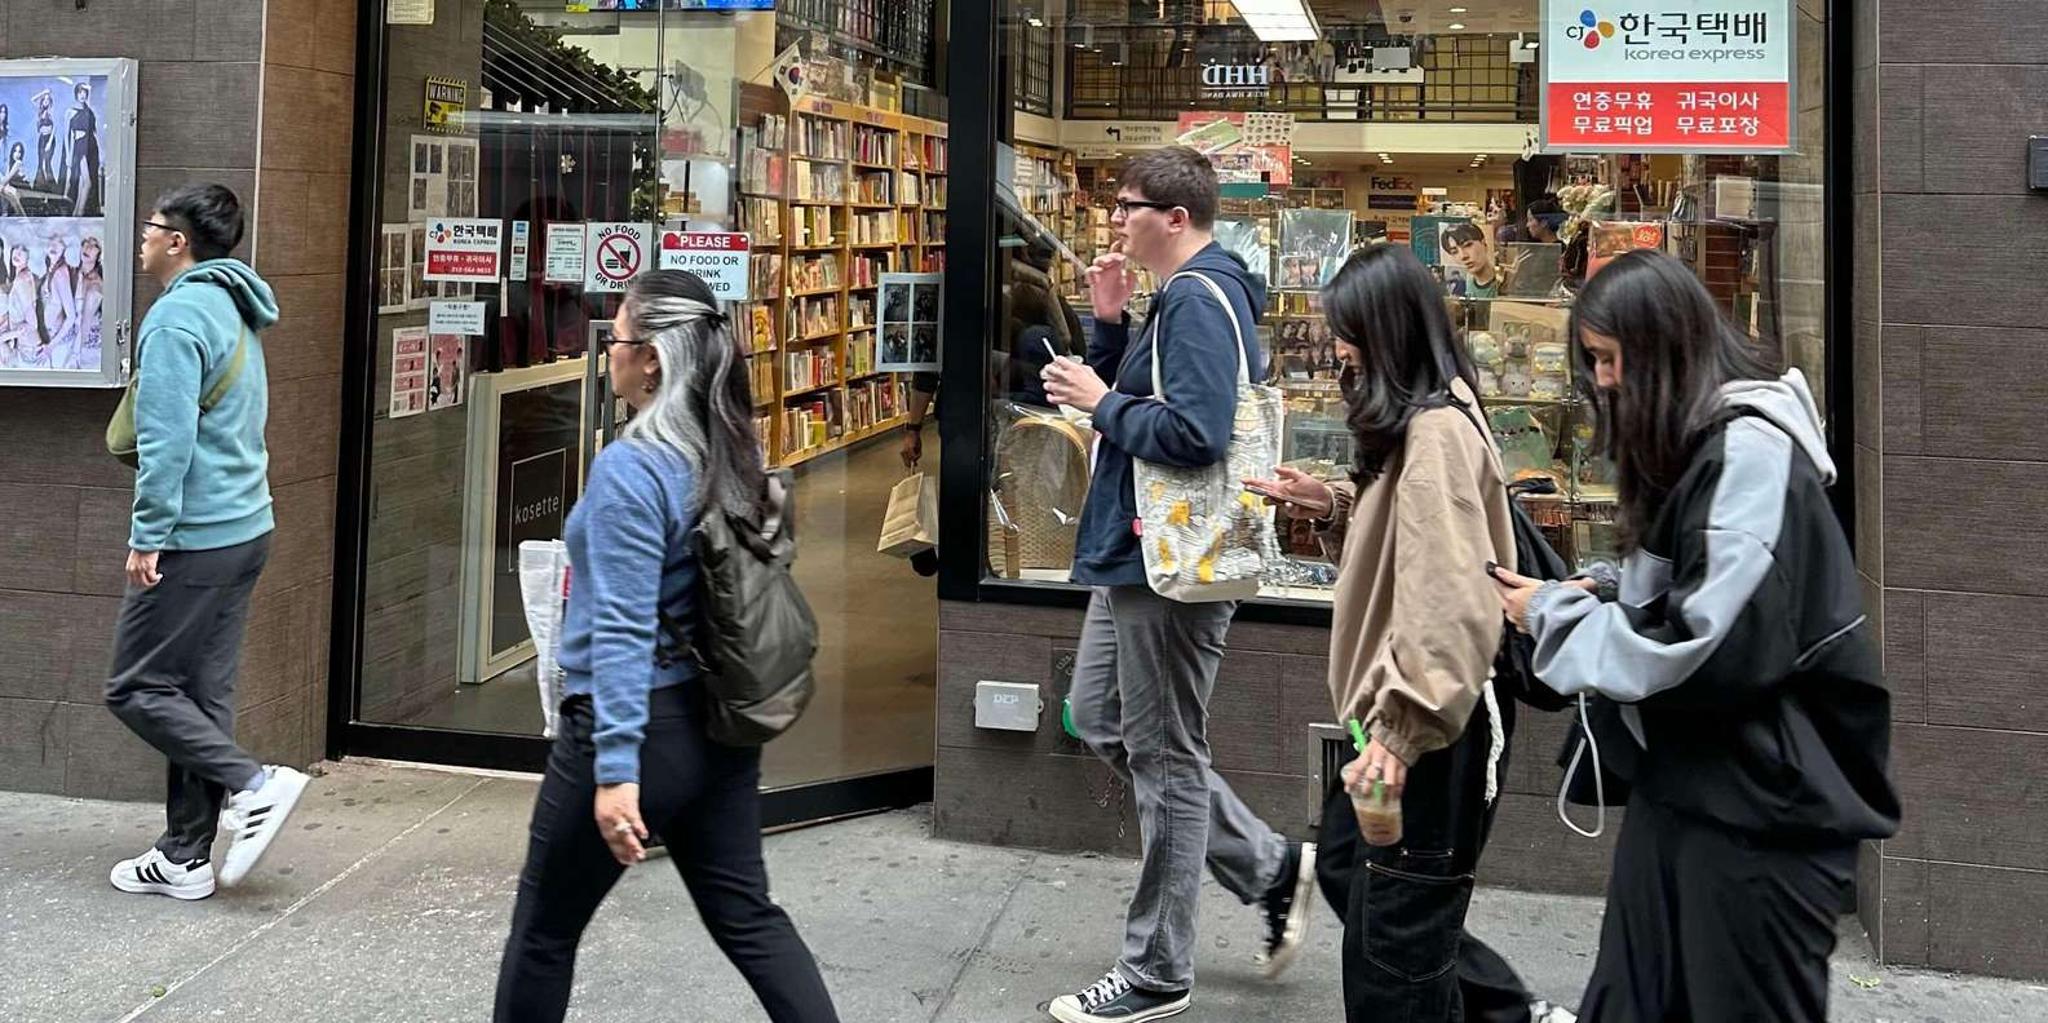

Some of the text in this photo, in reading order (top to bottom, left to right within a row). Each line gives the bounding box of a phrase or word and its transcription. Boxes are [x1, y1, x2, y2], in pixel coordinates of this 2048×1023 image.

[1566, 25, 1585, 41] CJ
[1619, 12, 1767, 45] 한국택배
[1625, 48, 1766, 63] korea express
[1573, 92, 1760, 110] 연중무휴 귀국이사
[1573, 115, 1760, 136] 무료픽업 무료포장
[1371, 176, 1414, 190] FedEx
[598, 224, 641, 240] NO FOOD
[680, 236, 731, 248] PLEASE
[671, 255, 739, 266] NO FOOD OR
[595, 272, 608, 286] OR
[515, 496, 559, 525] kosette
